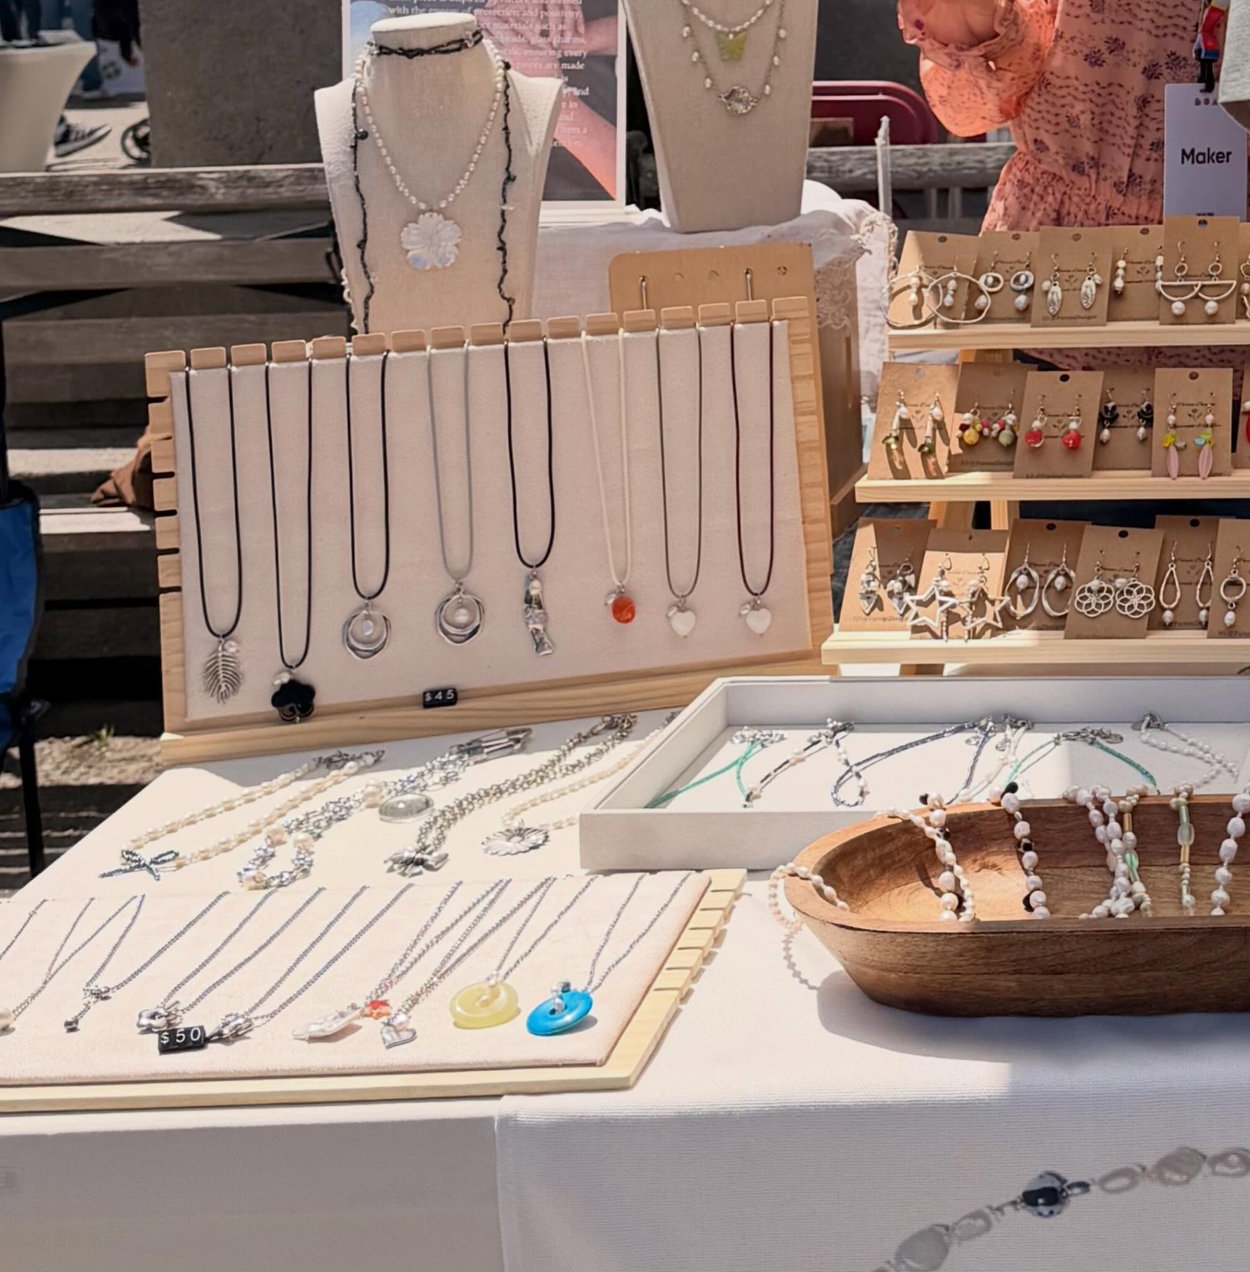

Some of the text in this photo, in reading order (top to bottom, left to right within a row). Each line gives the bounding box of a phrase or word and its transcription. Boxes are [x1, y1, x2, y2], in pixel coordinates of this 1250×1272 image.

[564, 50, 588, 59] every
[561, 60, 585, 70] made
[1181, 147, 1232, 165] Maker
[425, 689, 455, 702] $45
[160, 1027, 201, 1044] $50
